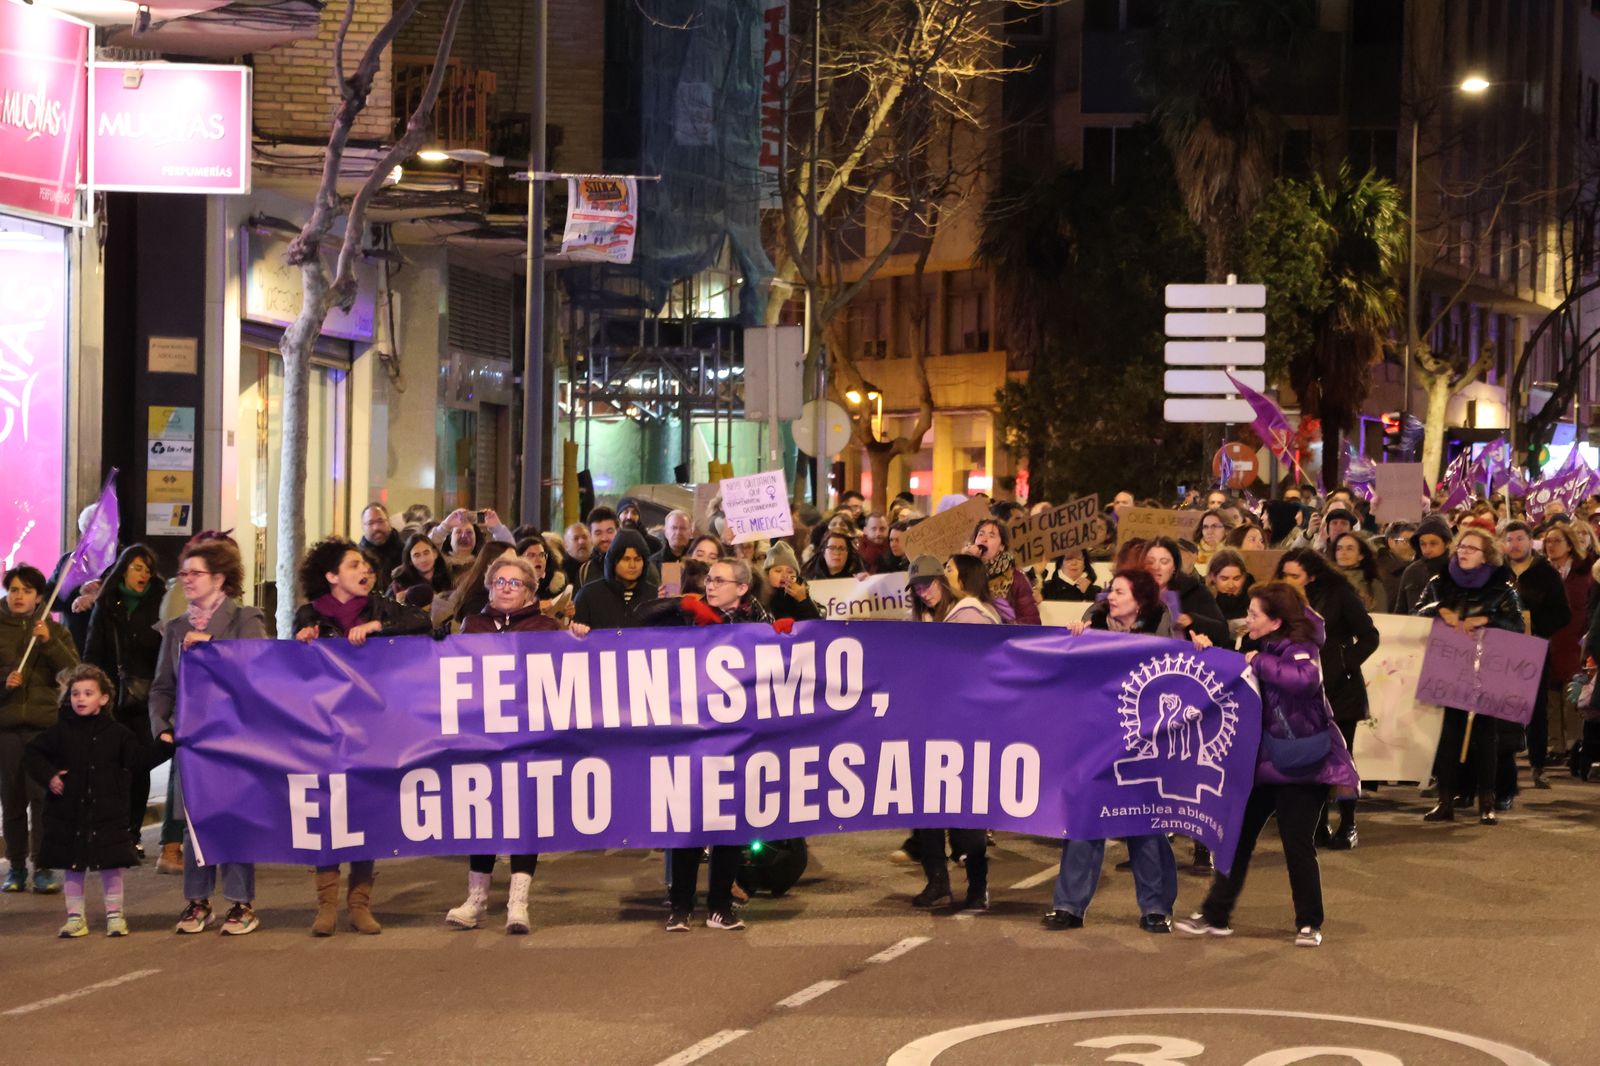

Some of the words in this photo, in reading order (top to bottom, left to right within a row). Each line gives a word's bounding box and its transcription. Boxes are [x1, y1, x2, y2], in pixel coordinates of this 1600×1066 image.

[736, 520, 746, 534] EL
[749, 515, 778, 532] MIEDO
[1011, 517, 1033, 540] MI
[1038, 497, 1096, 532] CUERPO
[1049, 518, 1097, 553] REGLAS
[438, 636, 890, 736] FEMINISMO,
[286, 772, 365, 851] EL
[399, 756, 613, 843] GRITO
[649, 738, 1041, 834] NECESARIO
[1099, 803, 1173, 818] Asamblea
[1150, 817, 1204, 836] Zamora
